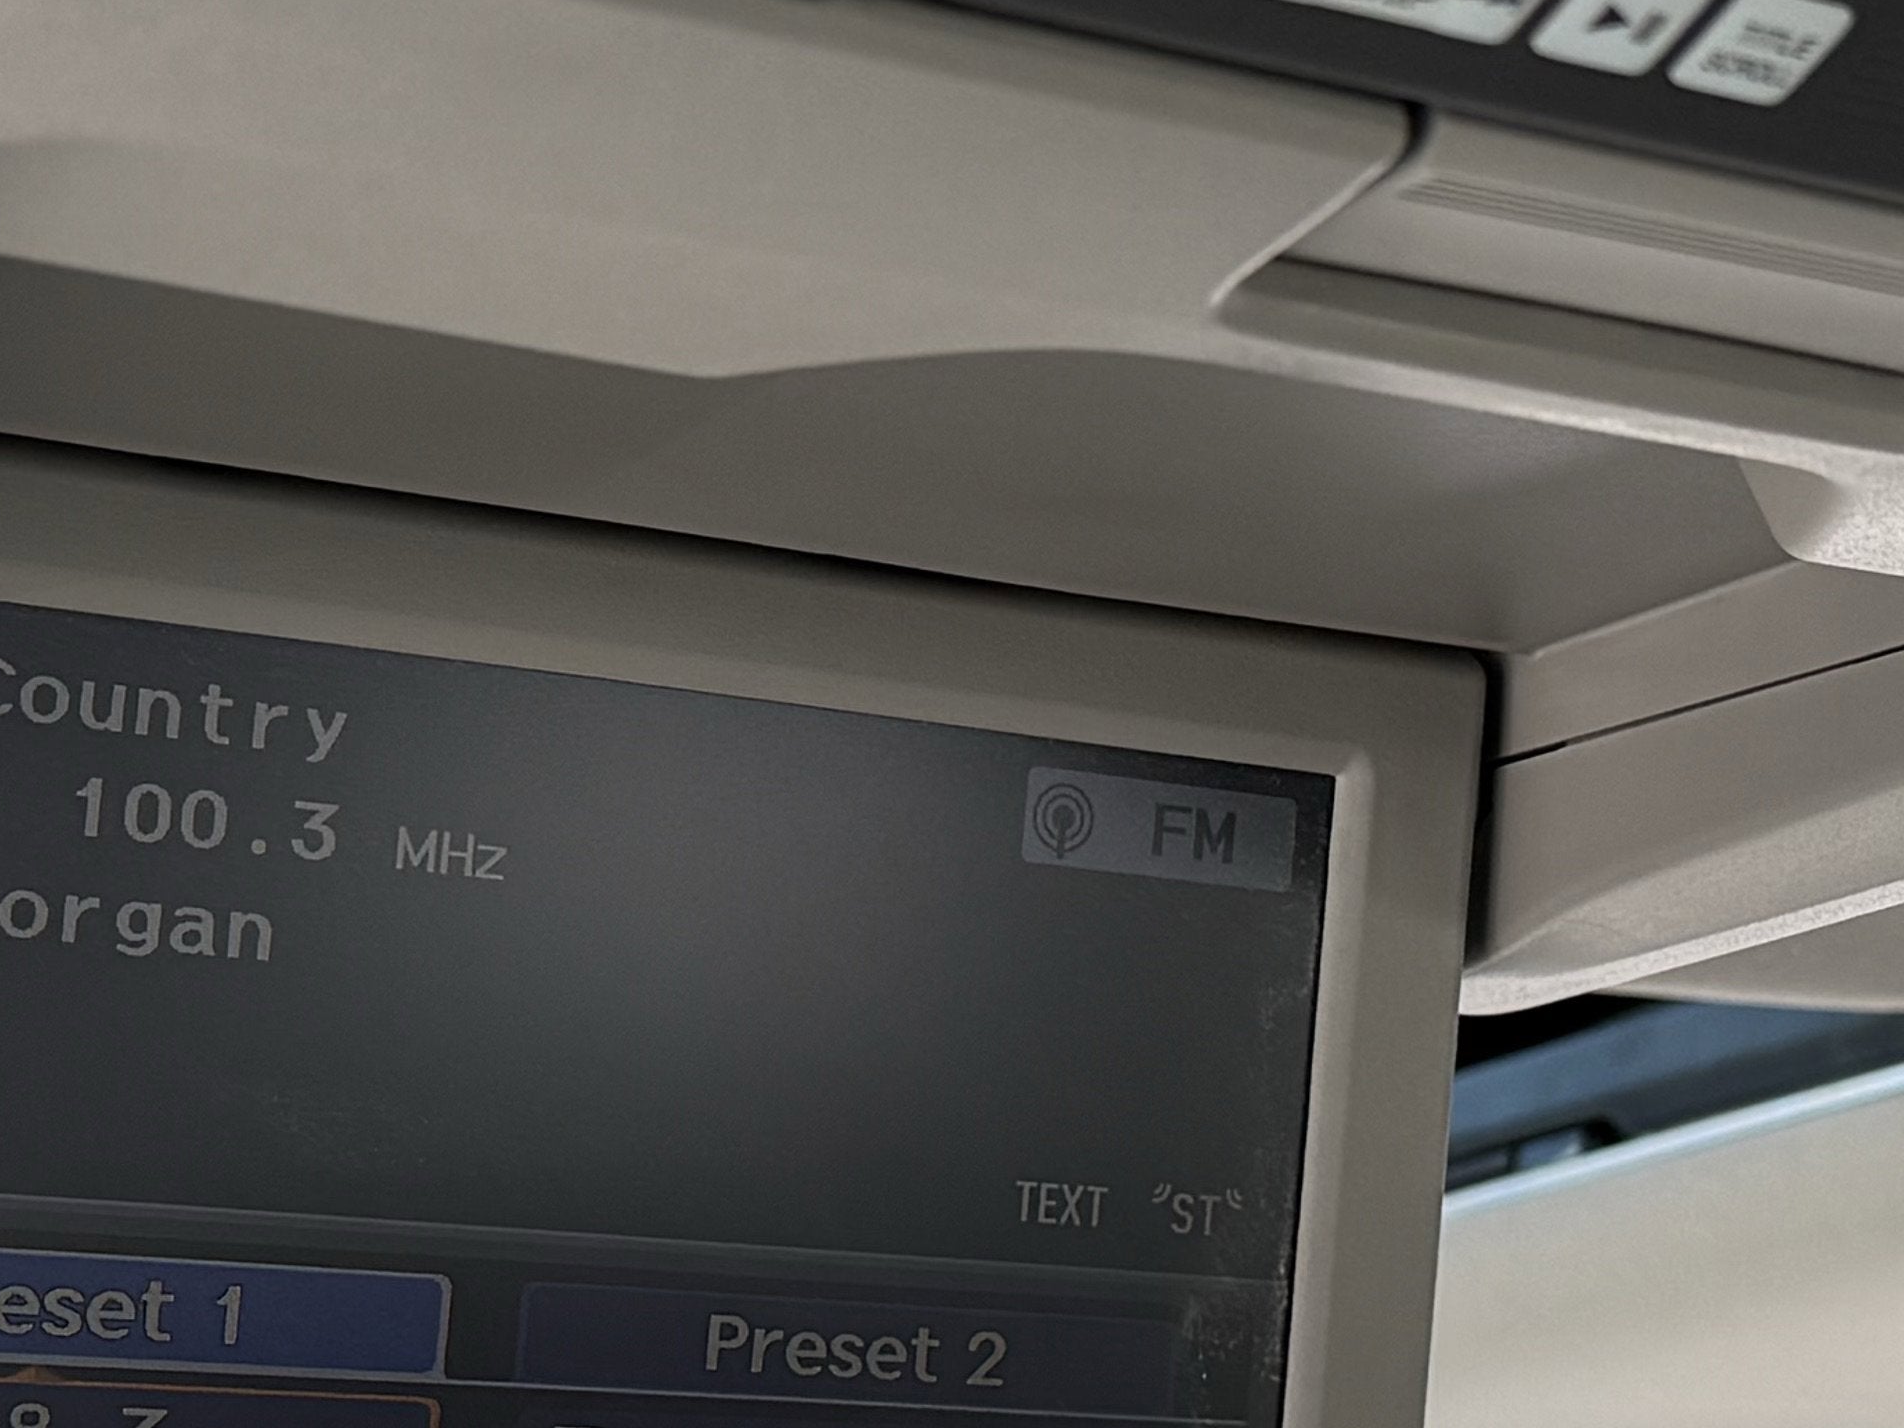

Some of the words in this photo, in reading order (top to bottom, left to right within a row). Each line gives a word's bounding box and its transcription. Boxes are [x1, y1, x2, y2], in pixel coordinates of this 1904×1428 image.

[73, 777, 338, 864] 100.3
[394, 827, 507, 882] MHz
[1149, 800, 1237, 867] FM
[1015, 1178, 1109, 1229] TEXT
[214, 1282, 246, 1347] 1
[704, 1311, 943, 1386] Preset
[965, 1328, 1010, 1389] 2
